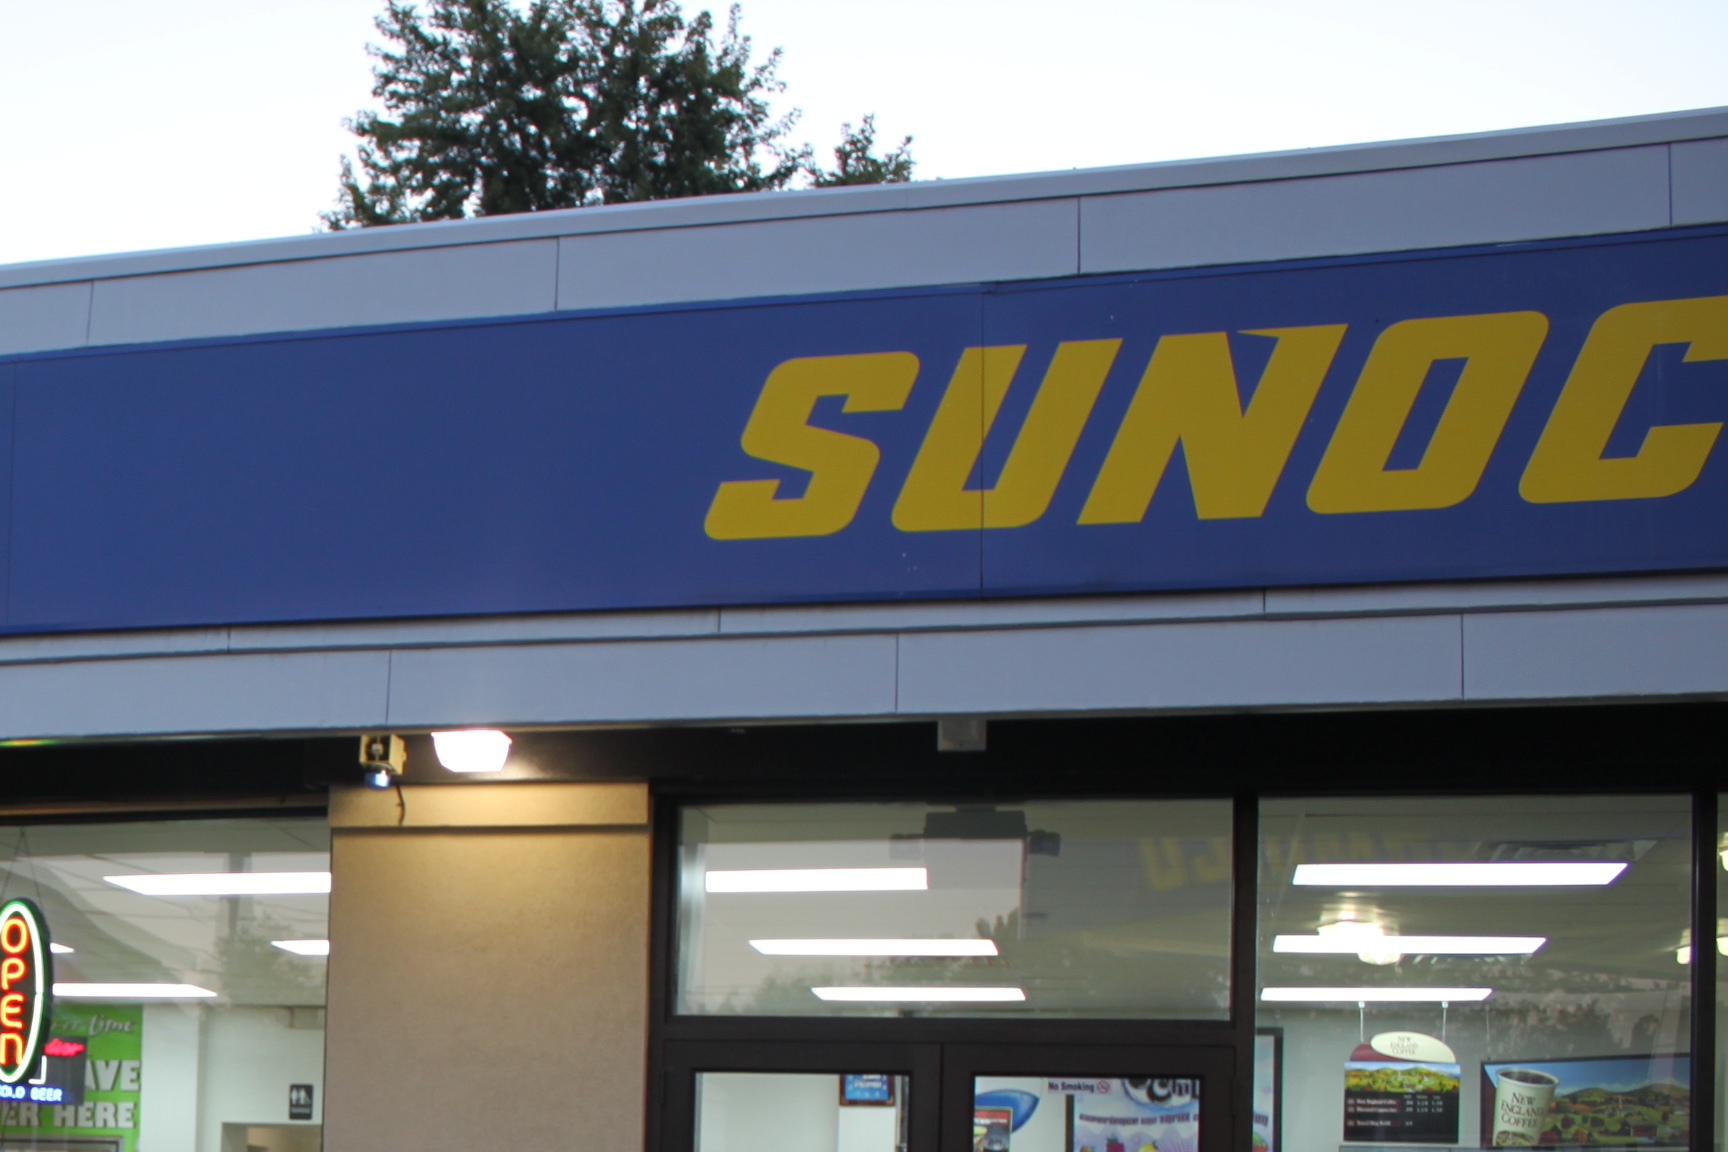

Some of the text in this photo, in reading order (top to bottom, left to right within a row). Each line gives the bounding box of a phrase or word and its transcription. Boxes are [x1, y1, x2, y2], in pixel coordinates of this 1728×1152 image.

[702, 294, 1728, 540] SUNOC
[30, 1086, 63, 1102] BEER
[1048, 1081, 1095, 1094] No Smoking
[1512, 1092, 1536, 1105] NEW
[53, 1101, 135, 1128] HERE
